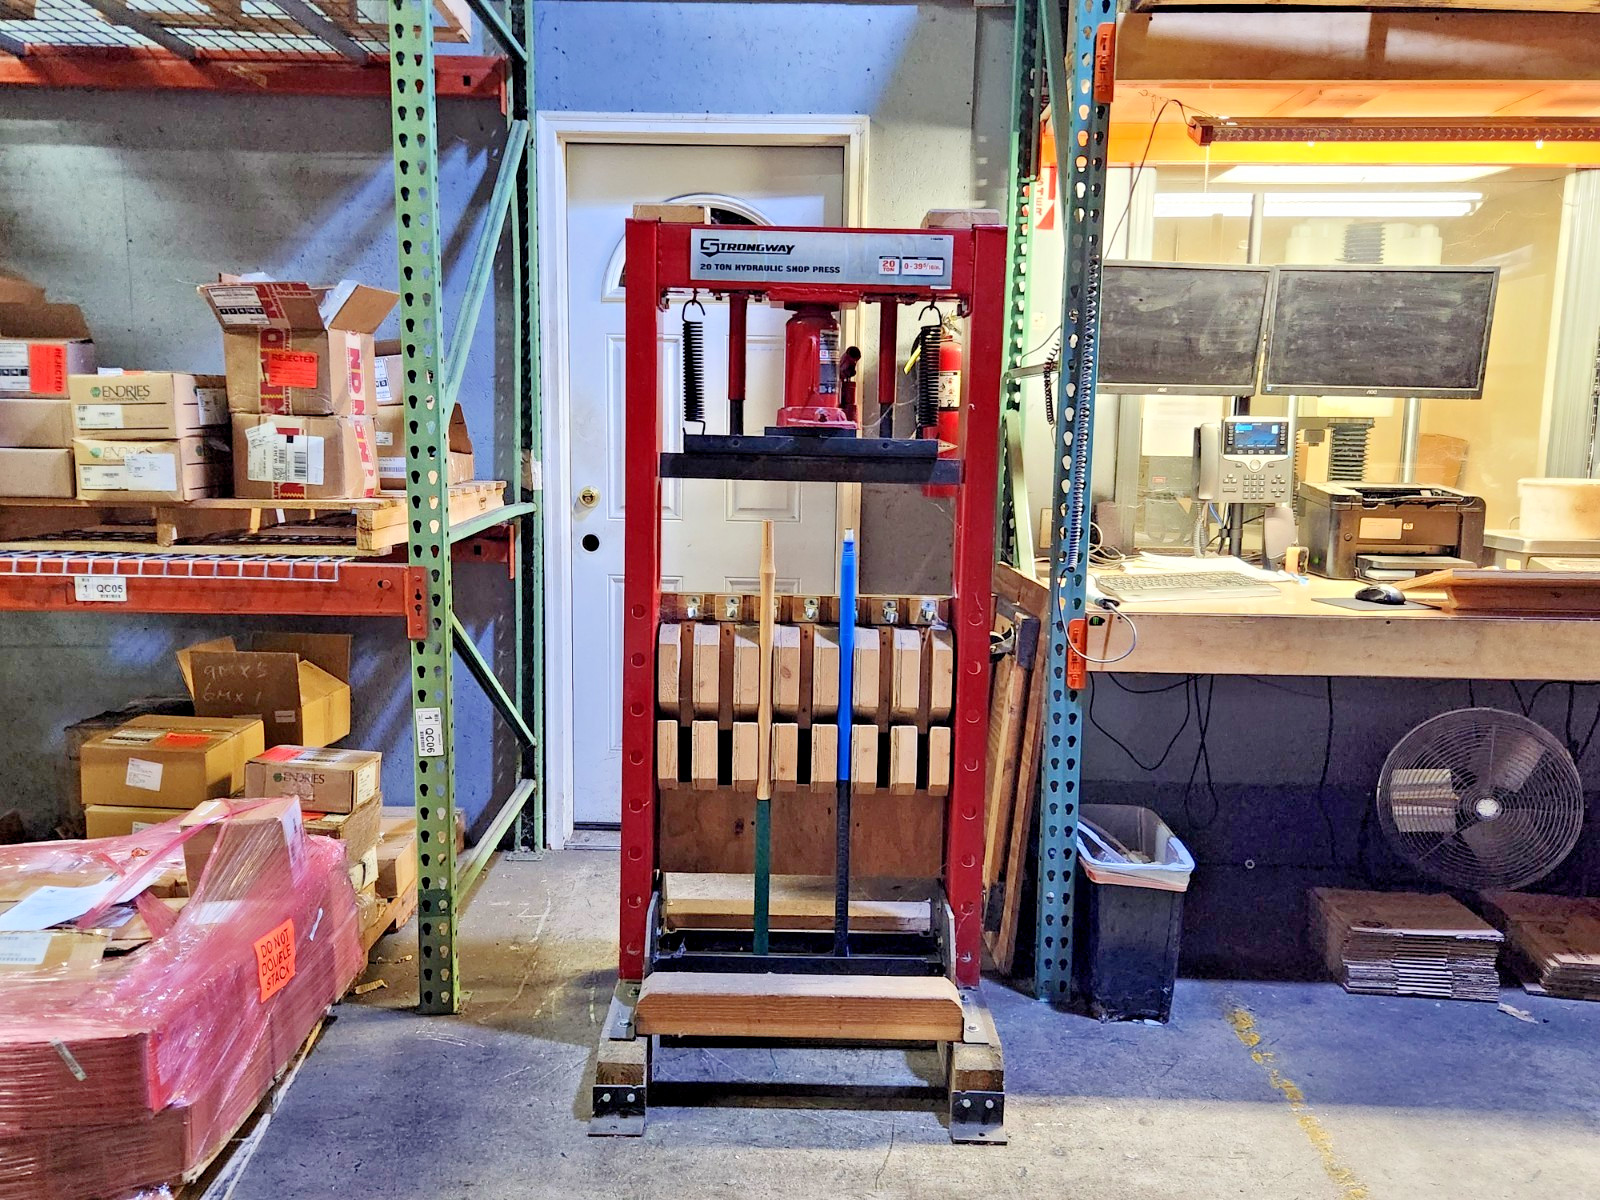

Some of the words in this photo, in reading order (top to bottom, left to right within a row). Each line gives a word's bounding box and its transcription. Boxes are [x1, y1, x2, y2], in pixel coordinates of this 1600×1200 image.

[700, 238, 795, 256] STRONGWAY
[700, 263, 712, 271] 20
[715, 263, 732, 271] TON
[735, 264, 783, 273] HYDRAULIC
[786, 265, 810, 273] SHOP
[812, 266, 841, 274] PRESS
[882, 260, 896, 268] 20
[271, 353, 315, 364] REJECTED
[54, 348, 62, 391] REJECTED
[102, 385, 150, 400] ENDRIES
[83, 584, 88, 592] 1
[96, 584, 123, 593] QC05
[425, 727, 435, 753] QC06
[283, 772, 325, 784] ENDRIES
[261, 940, 273, 958] DO
[273, 928, 289, 949] NOT
[262, 943, 291, 977] DOUBLE
[267, 961, 290, 991] STACK
